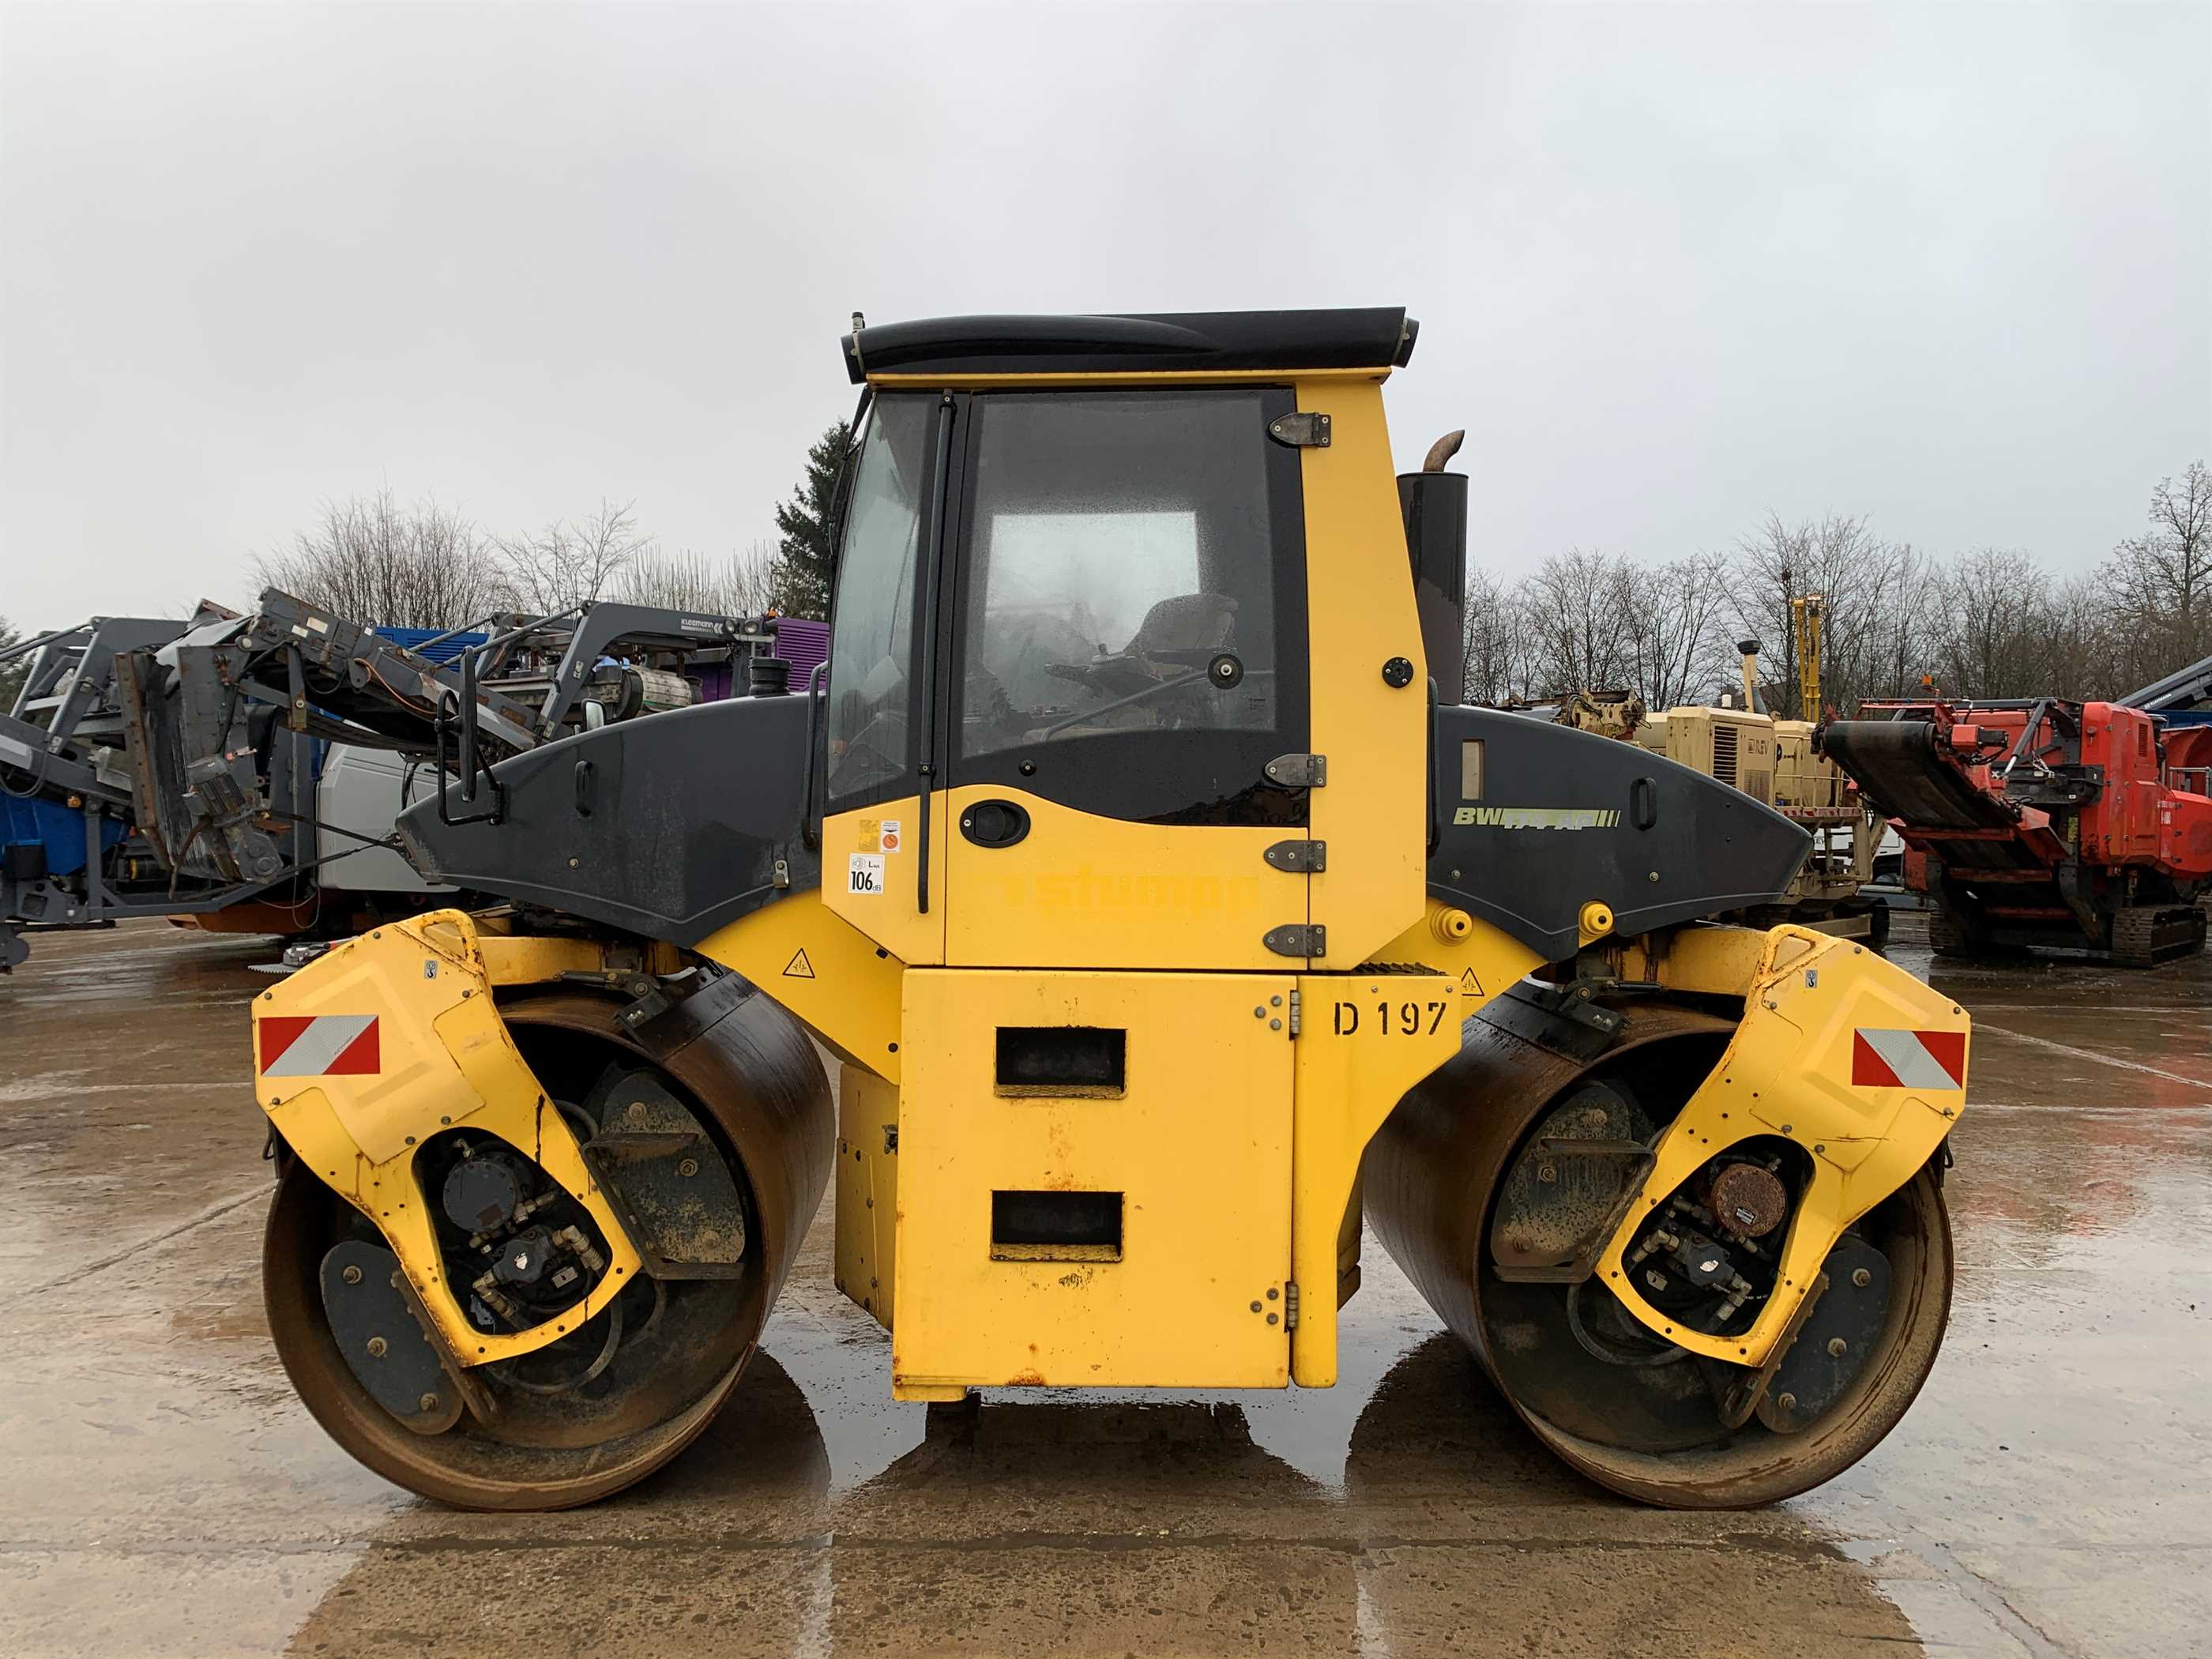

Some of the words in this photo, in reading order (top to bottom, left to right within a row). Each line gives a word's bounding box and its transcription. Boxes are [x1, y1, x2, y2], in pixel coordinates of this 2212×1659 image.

[1453, 807, 1503, 826] BW
[851, 871, 873, 890] 106
[1334, 1002, 1359, 1036] D
[1378, 1002, 1447, 1036] 197
